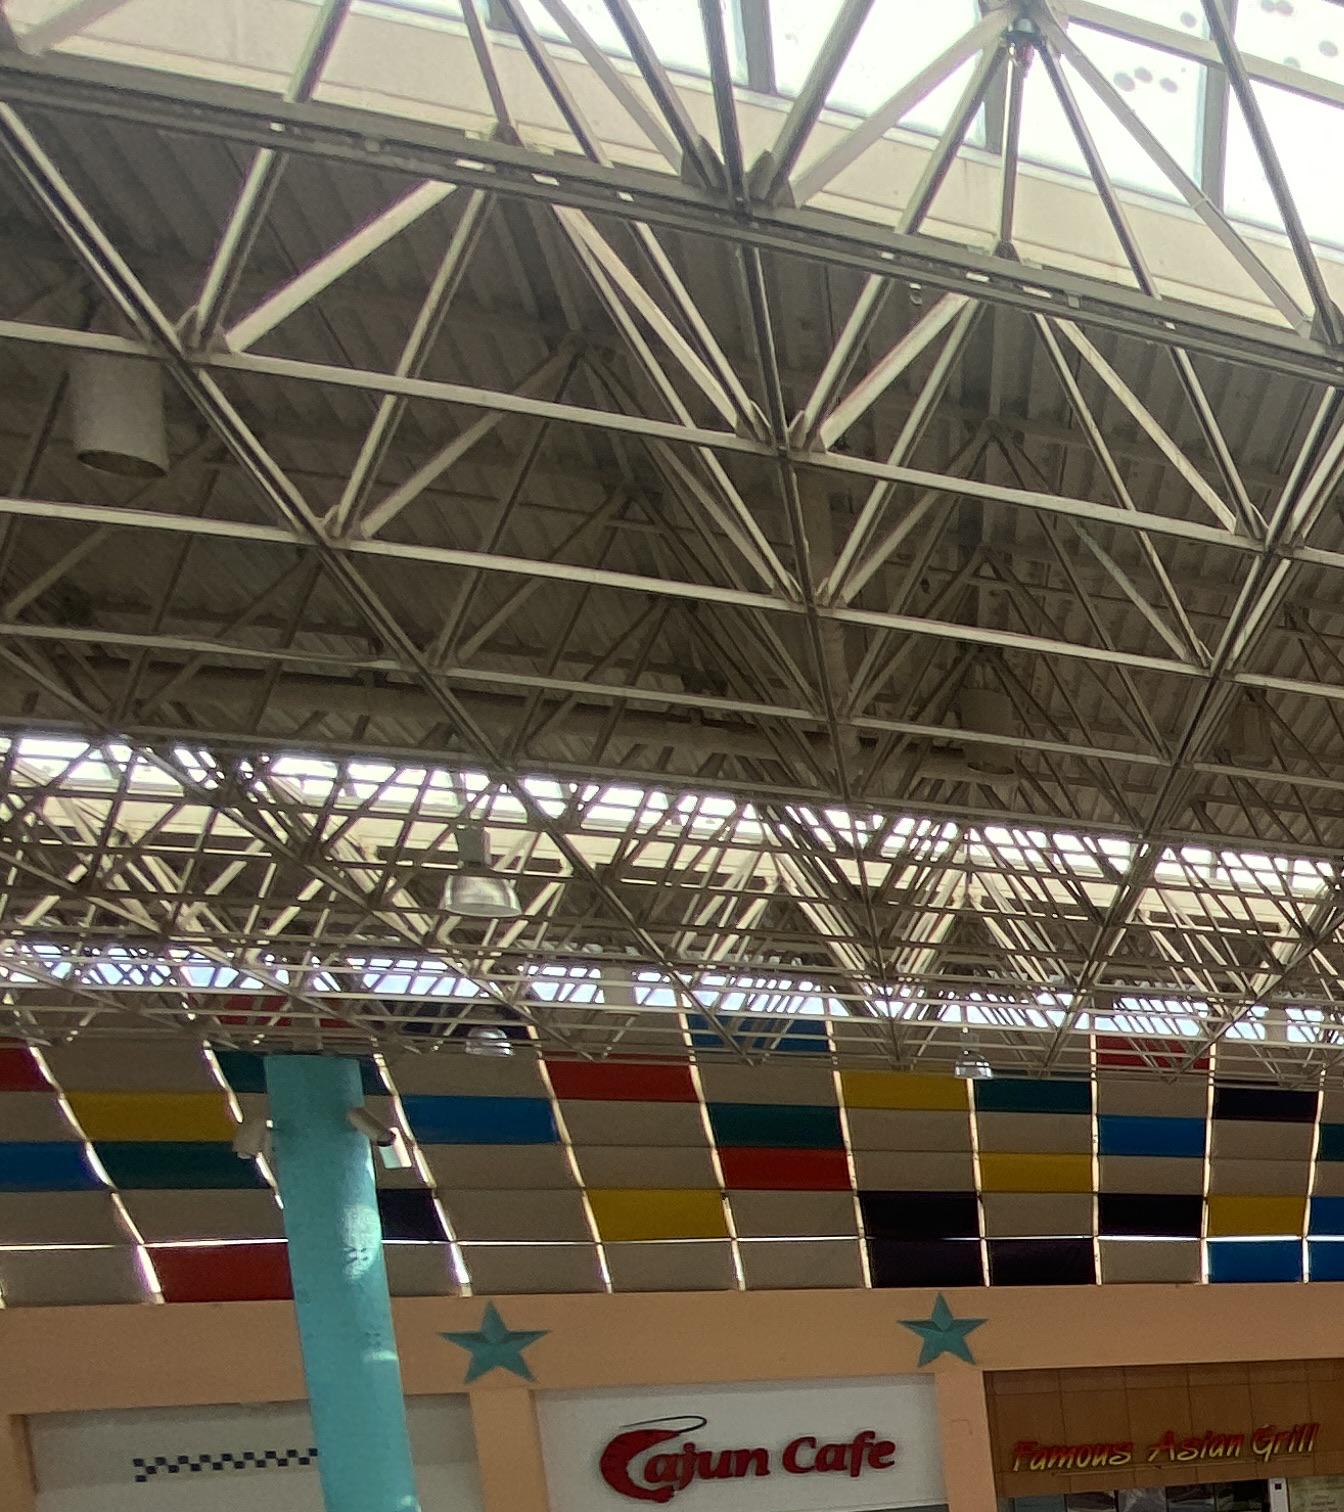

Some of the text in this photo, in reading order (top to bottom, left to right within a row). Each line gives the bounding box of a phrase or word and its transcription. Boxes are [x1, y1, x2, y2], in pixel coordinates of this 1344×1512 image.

[600, 1416, 897, 1503] Cajun Cafe
[1012, 1422, 1321, 1473] Famous Asian Grill
